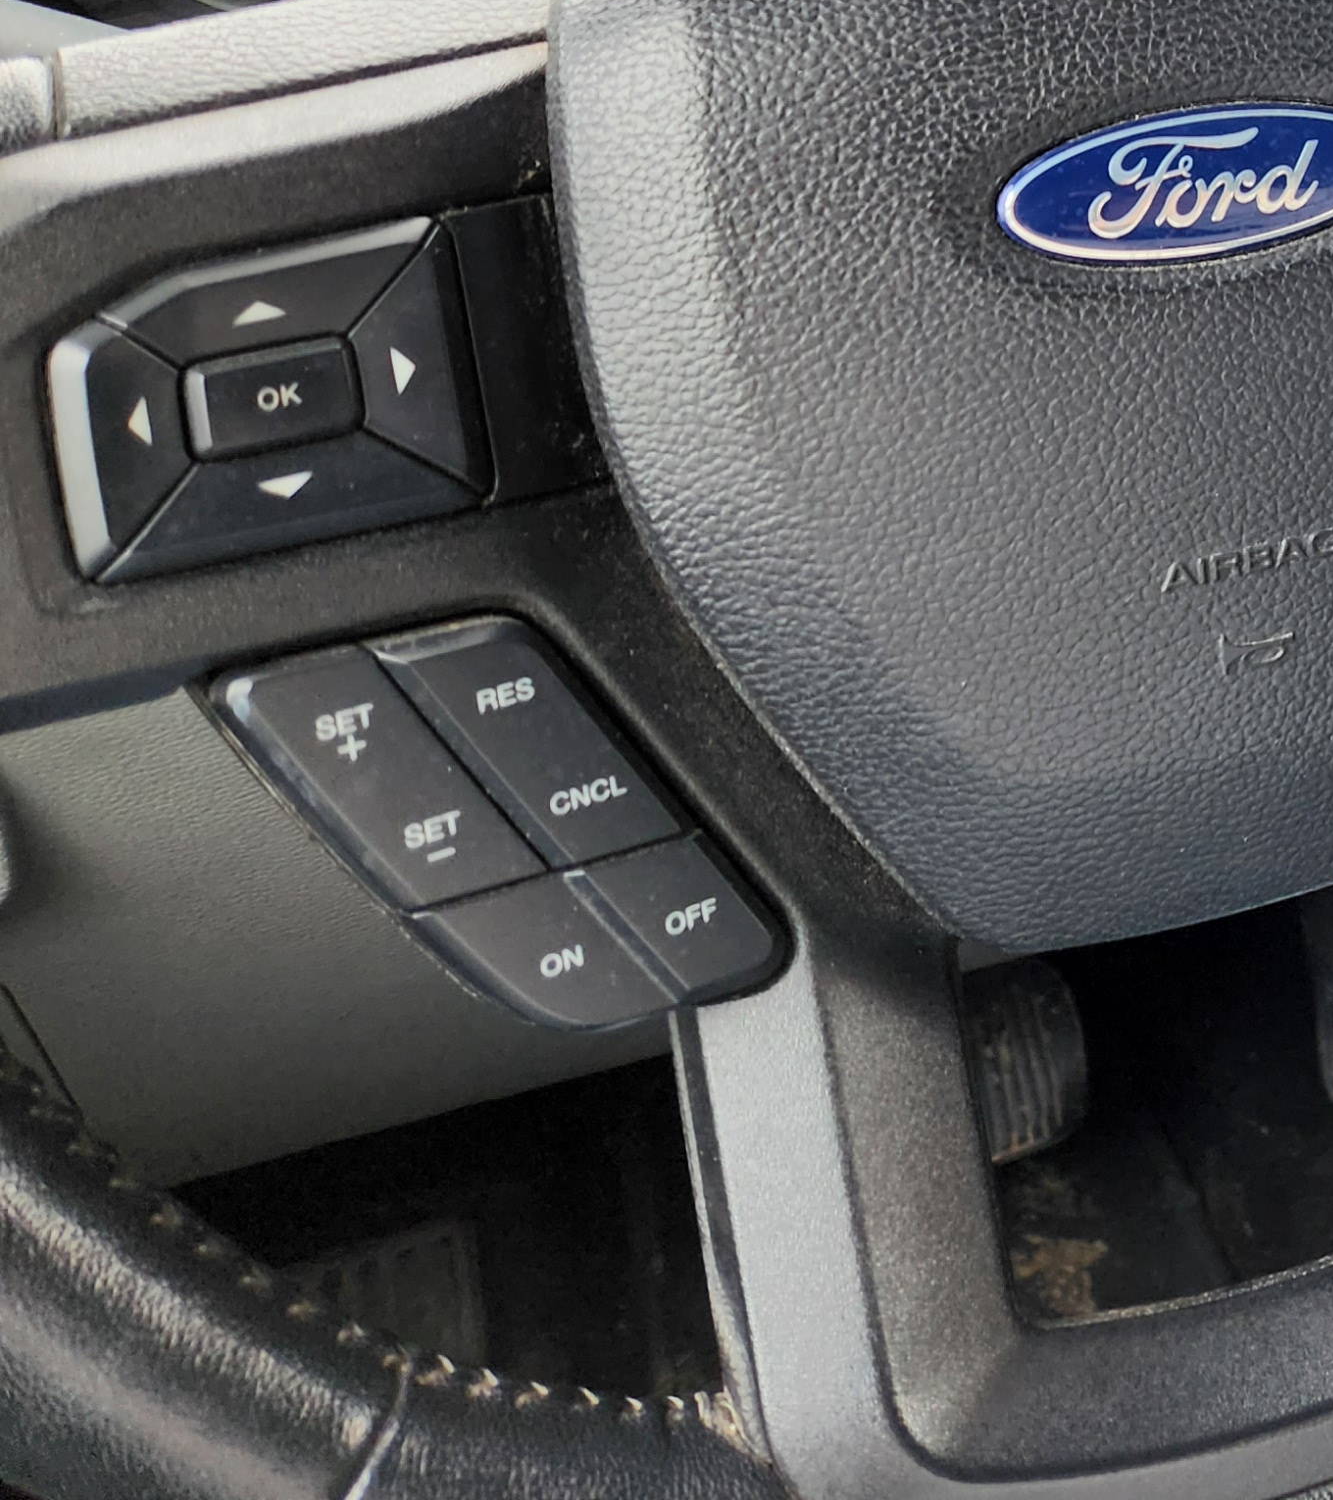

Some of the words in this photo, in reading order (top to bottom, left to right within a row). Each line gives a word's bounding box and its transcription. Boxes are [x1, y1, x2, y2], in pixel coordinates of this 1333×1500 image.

[1088, 126, 1319, 240] Ford
[257, 381, 303, 412] OK
[476, 676, 536, 715] RES
[315, 702, 374, 742] SET
[549, 775, 628, 816] CNCL
[404, 809, 461, 850] SET
[664, 897, 717, 936] OFF
[539, 944, 585, 978] ON
